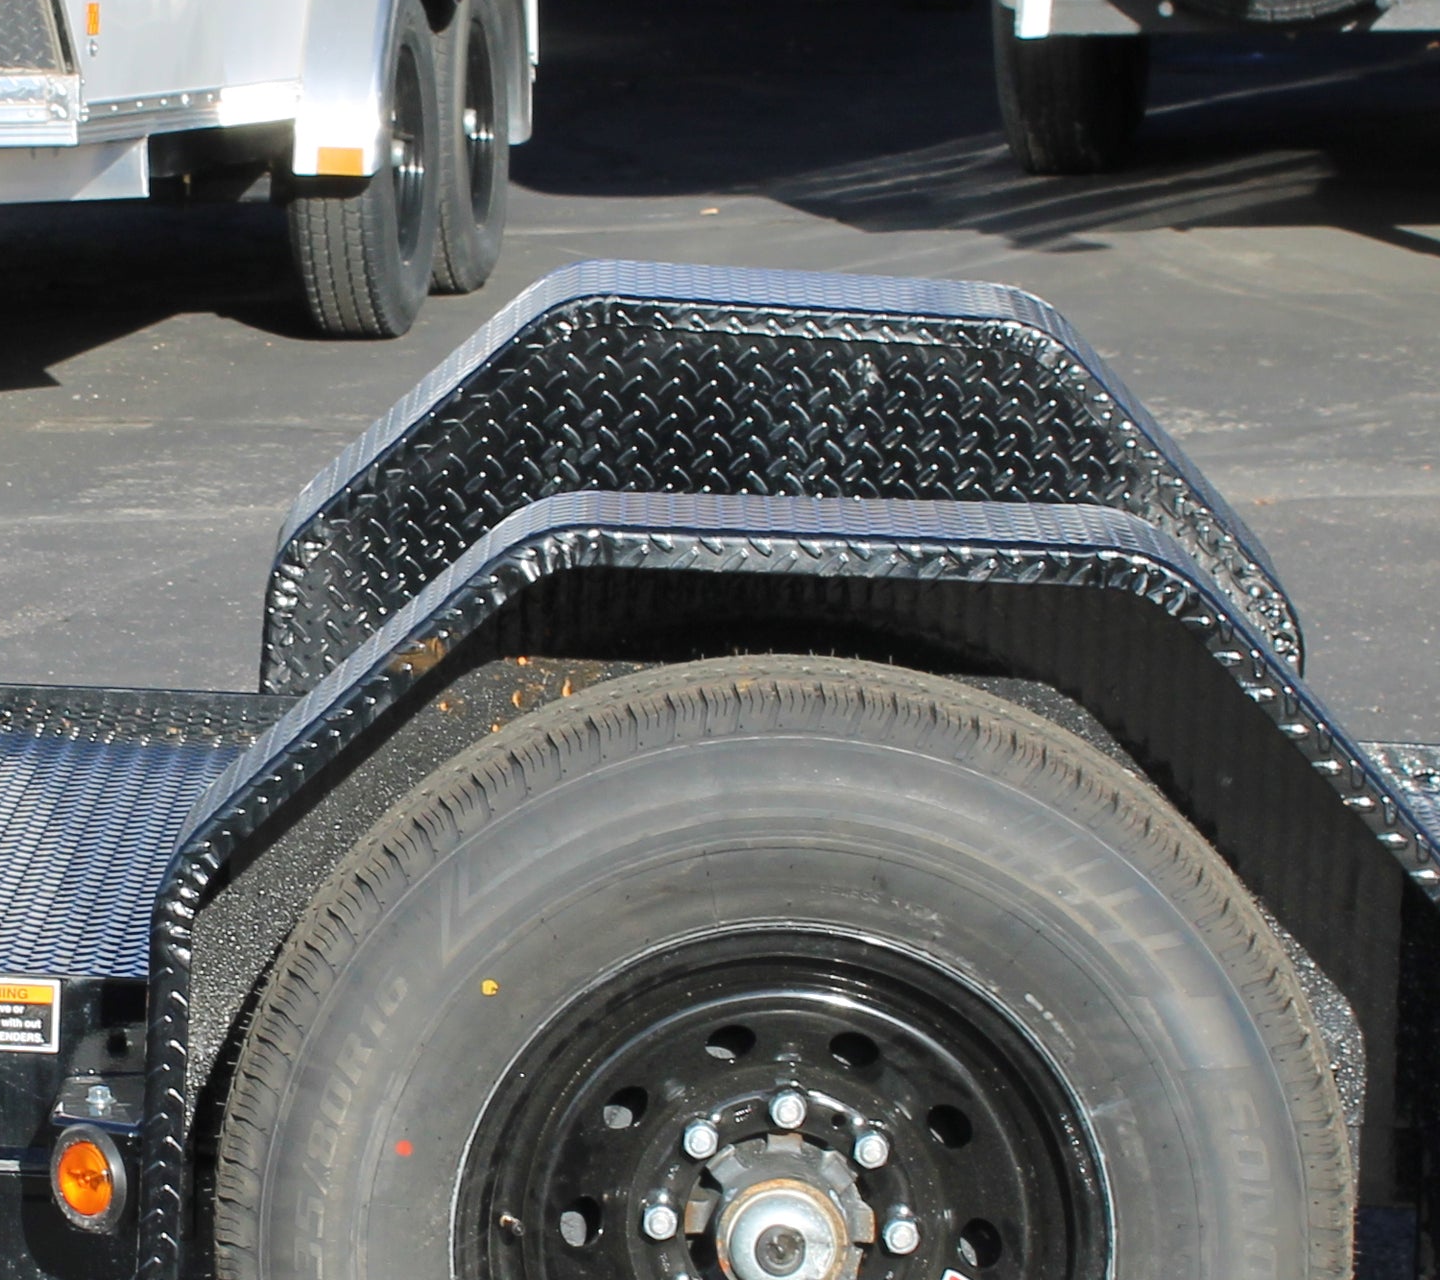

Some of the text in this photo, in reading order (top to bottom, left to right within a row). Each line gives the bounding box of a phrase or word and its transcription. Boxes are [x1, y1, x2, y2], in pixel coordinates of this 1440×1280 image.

[12, 1004, 25, 1014] or
[1, 1017, 23, 1028] with
[24, 1019, 42, 1029] out
